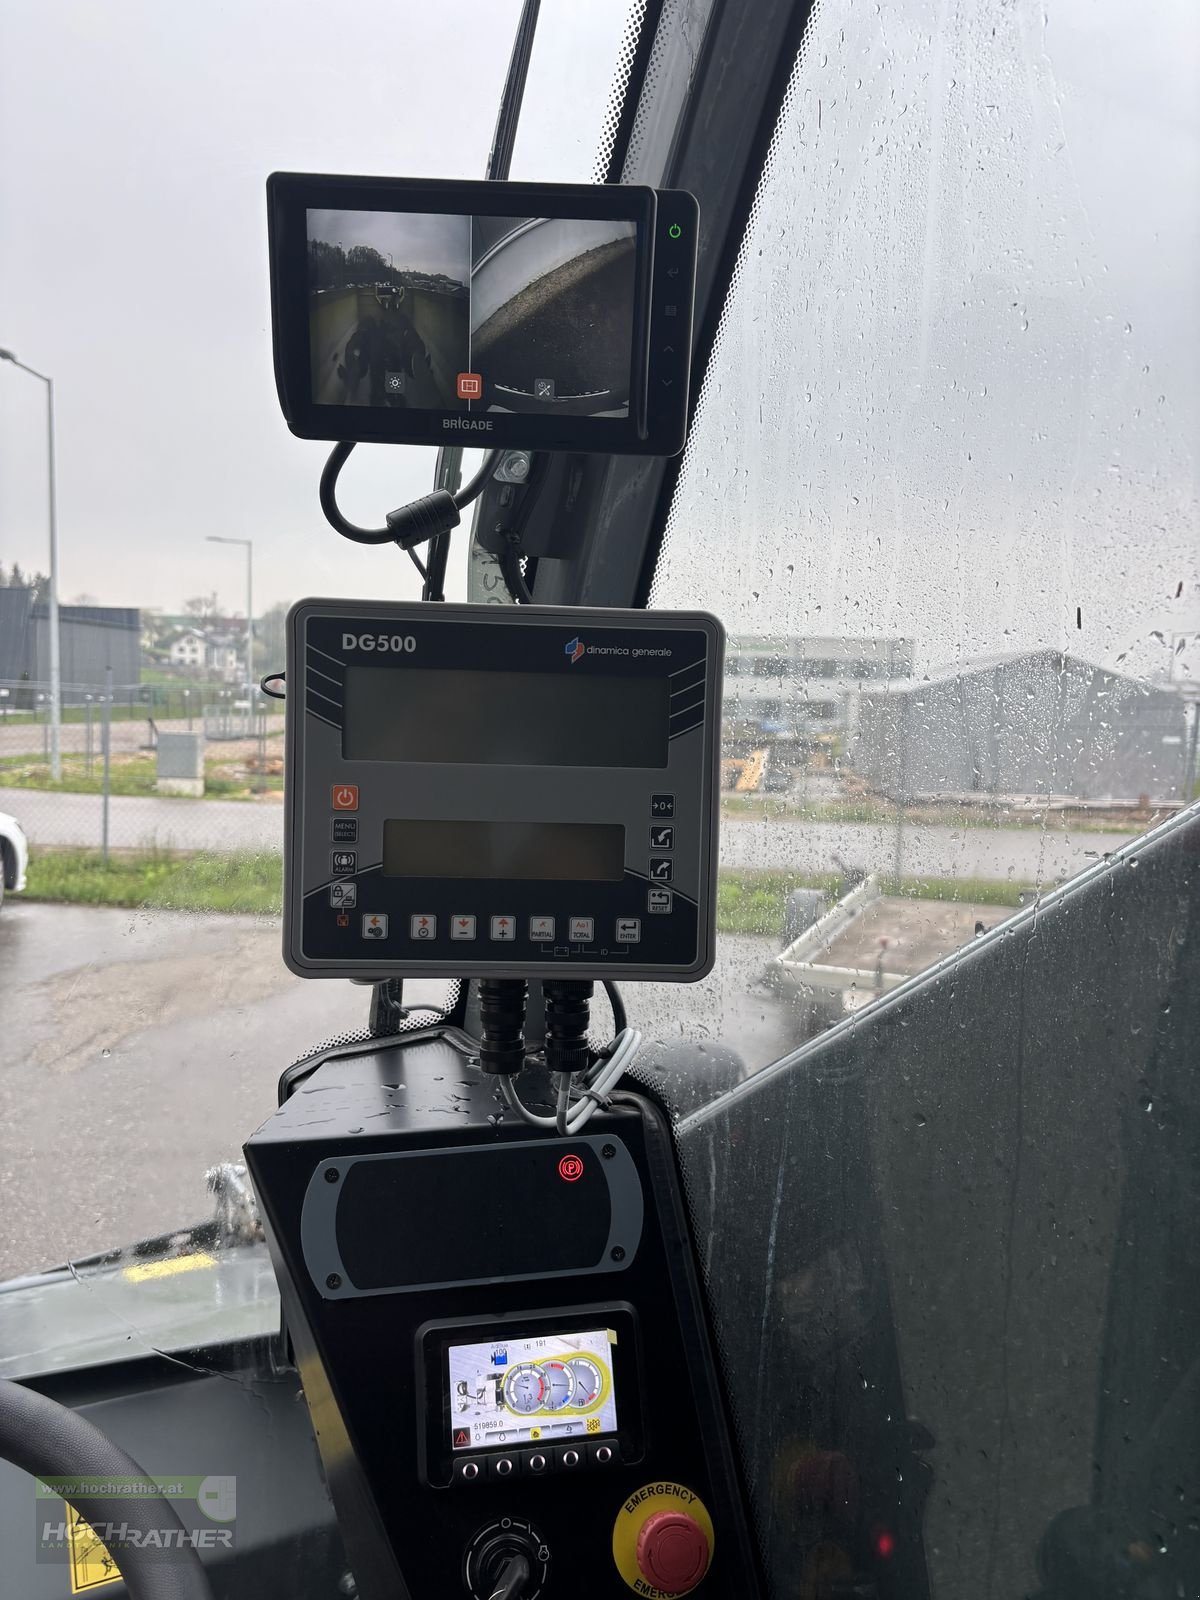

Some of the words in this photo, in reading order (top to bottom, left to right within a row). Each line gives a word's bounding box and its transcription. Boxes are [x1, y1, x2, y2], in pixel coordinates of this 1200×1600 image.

[442, 416, 494, 431] BRIGADE
[341, 633, 417, 653] DG500
[586, 645, 630, 657] dinamica
[632, 646, 673, 658] generale
[600, 948, 609, 956] ID
[624, 1483, 697, 1514] EMERGENCY
